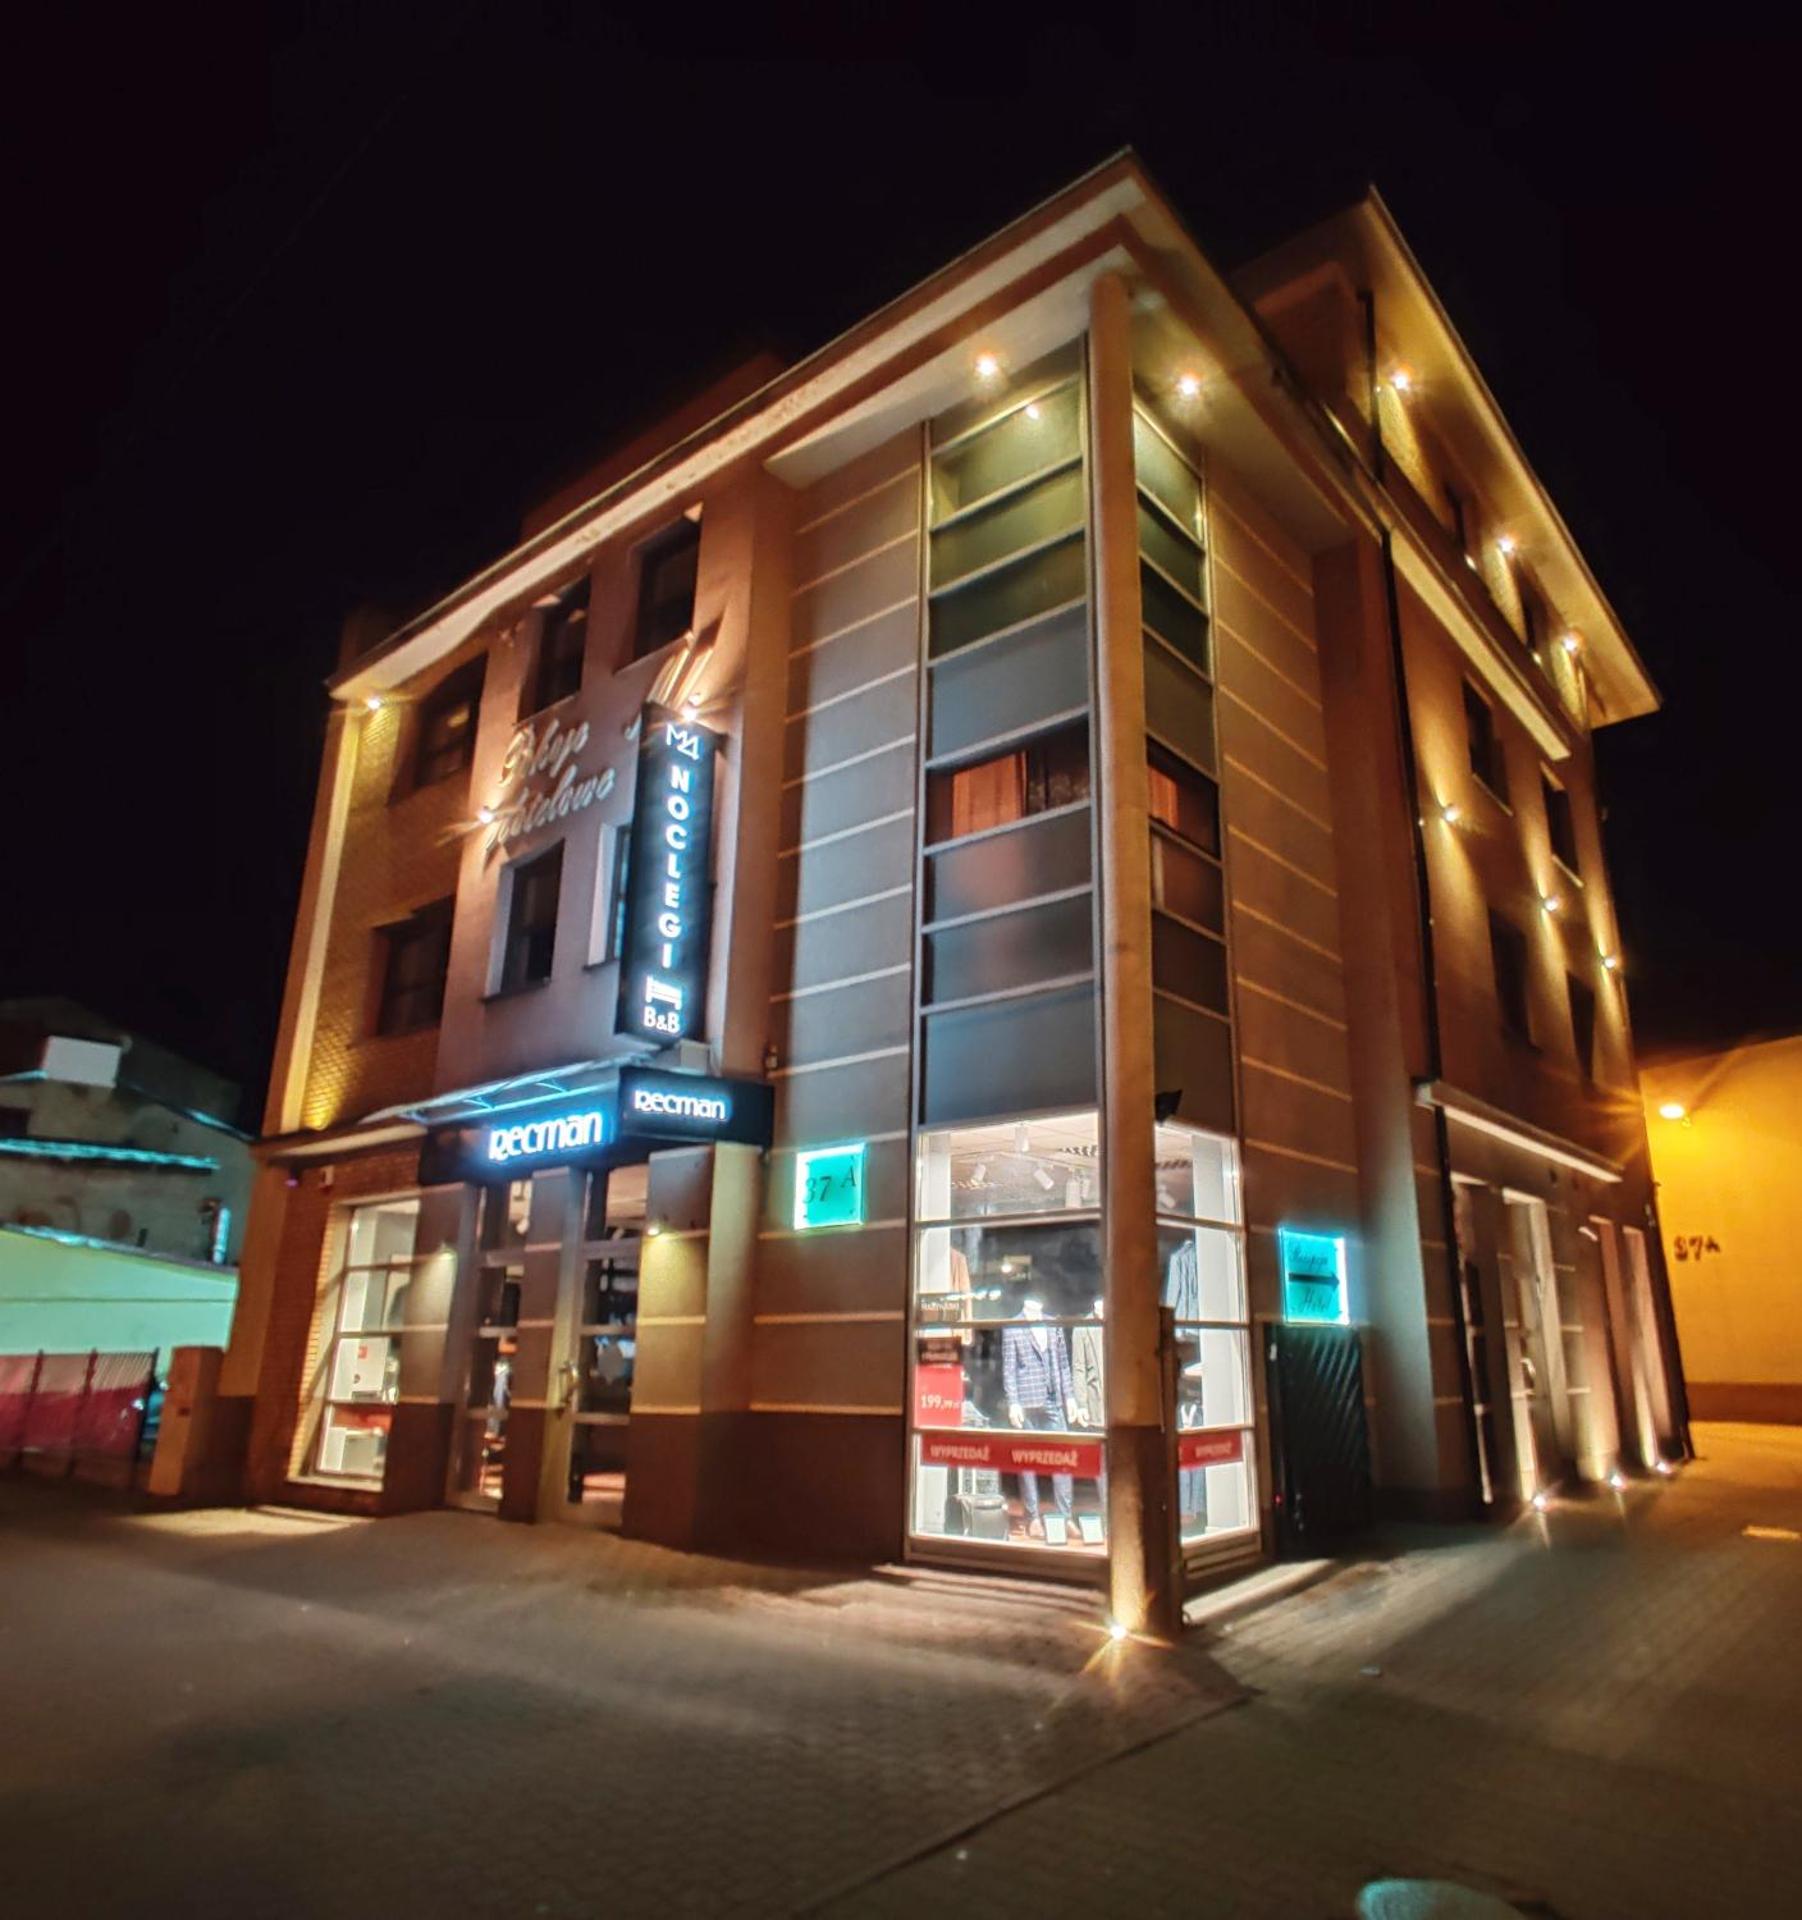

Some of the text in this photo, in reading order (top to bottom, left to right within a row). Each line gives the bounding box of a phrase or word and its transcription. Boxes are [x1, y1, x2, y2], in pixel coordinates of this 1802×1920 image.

[658, 764, 691, 969] NOCLEGI
[644, 1006, 680, 1033] B&B
[930, 1444, 1079, 1467] WYPRZEDAŻ WYPRZEDAŻ
